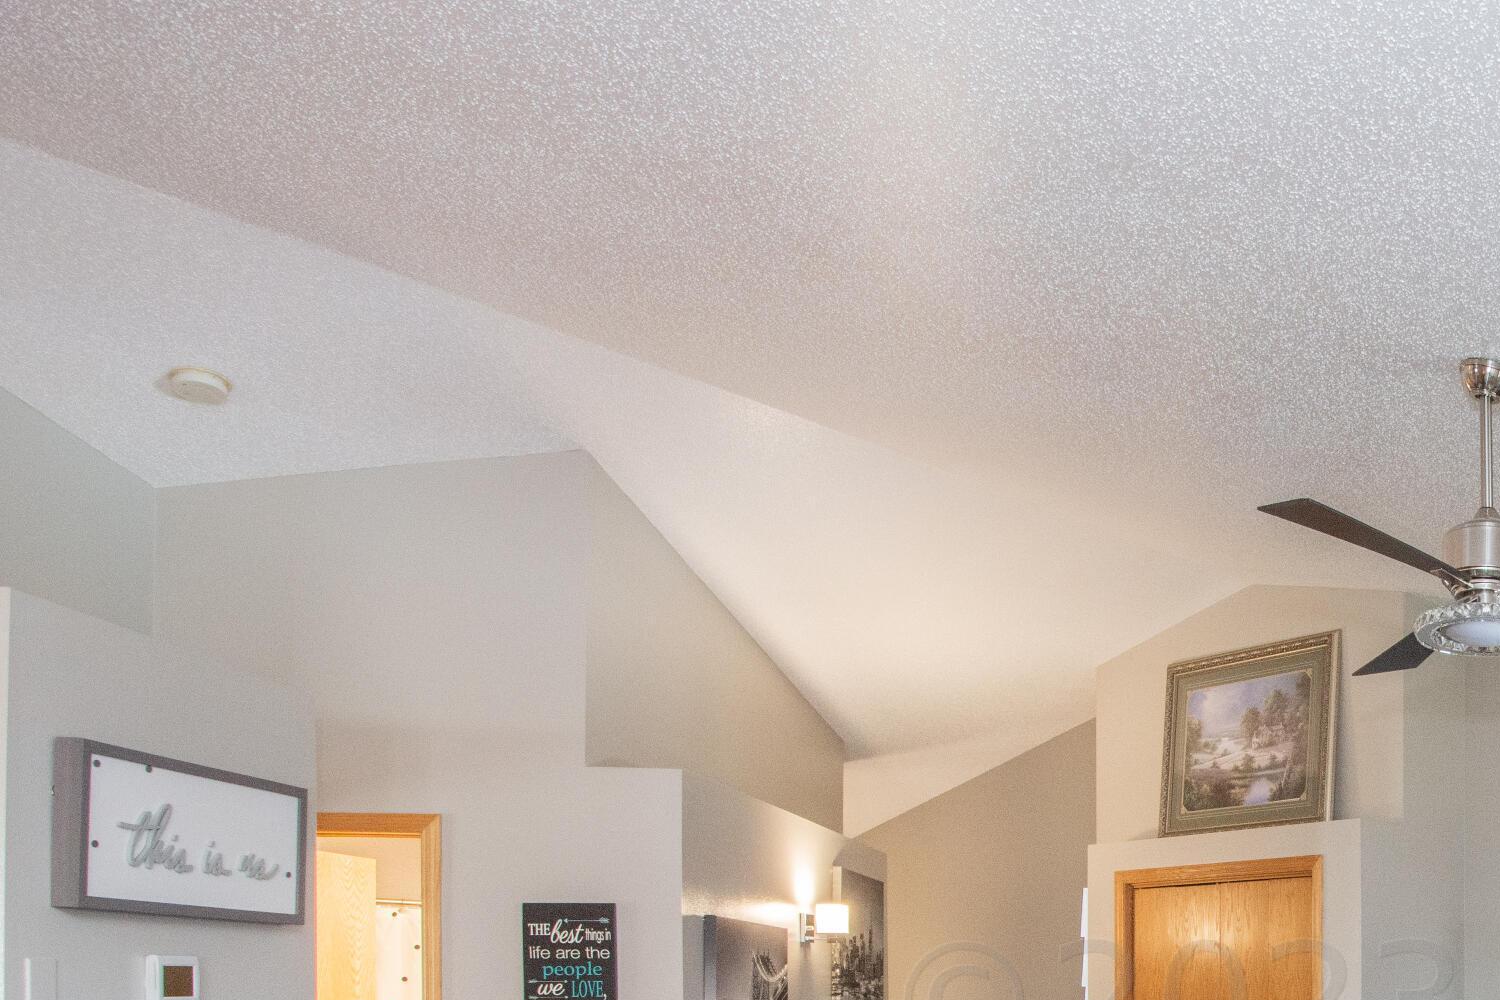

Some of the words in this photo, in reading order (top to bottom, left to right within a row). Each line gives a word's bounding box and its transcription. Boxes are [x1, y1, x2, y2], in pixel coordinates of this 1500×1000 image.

[117, 803, 194, 874] this
[203, 841, 233, 876] is
[527, 923, 551, 936] THE
[550, 918, 585, 944] best
[585, 927, 605, 944] things
[604, 927, 612, 941] in
[528, 946, 551, 960] life
[555, 948, 581, 960] are
[585, 946, 611, 960] the
[542, 961, 603, 980] people
[537, 983, 566, 996] we
[572, 980, 607, 1000] LOVE,
